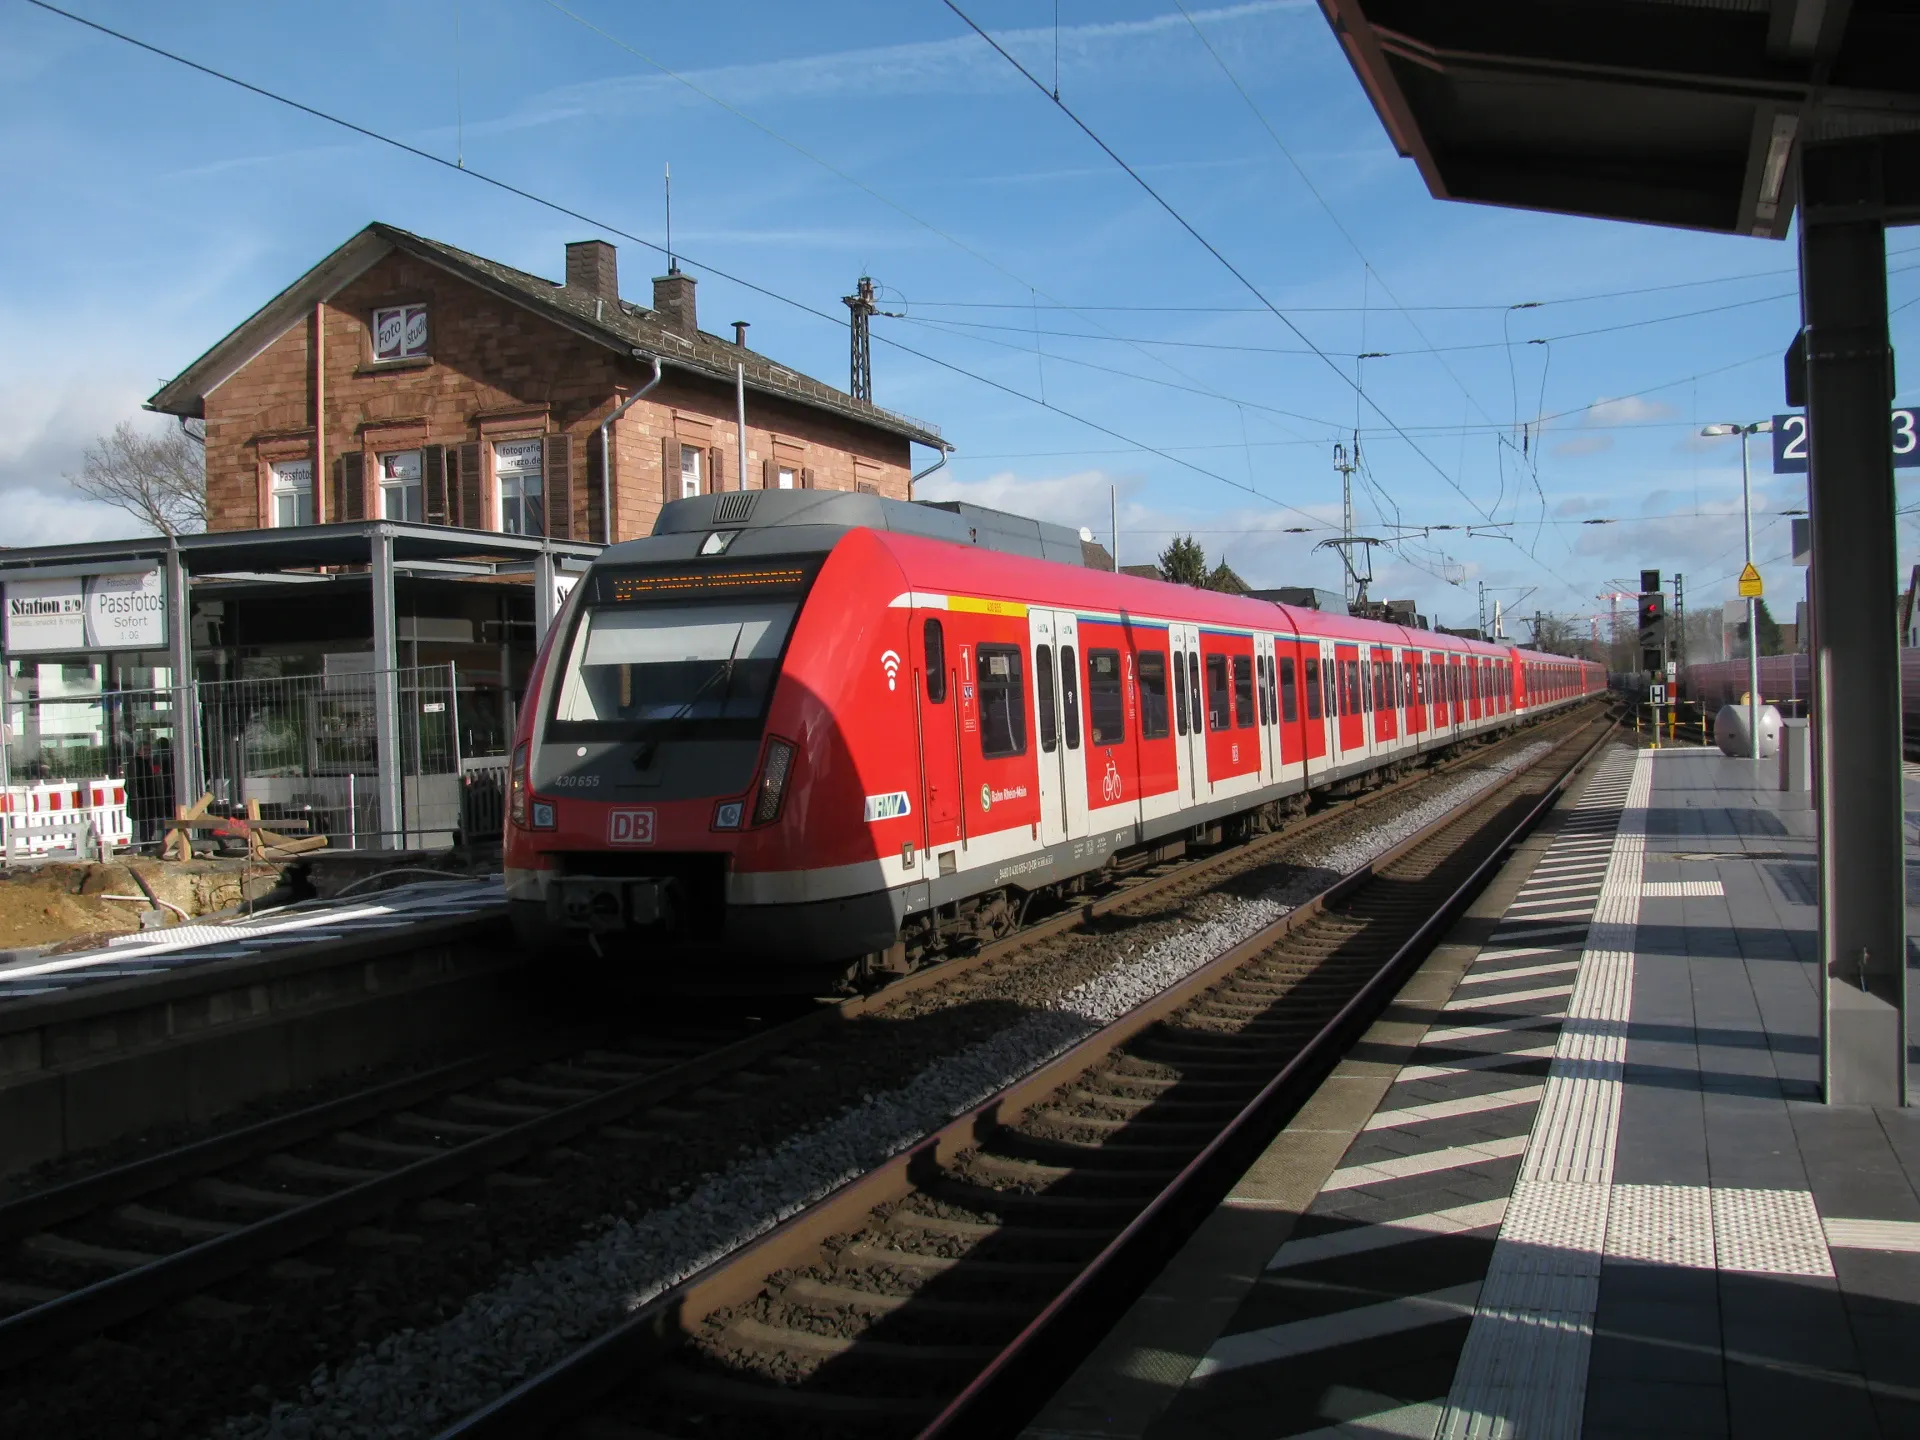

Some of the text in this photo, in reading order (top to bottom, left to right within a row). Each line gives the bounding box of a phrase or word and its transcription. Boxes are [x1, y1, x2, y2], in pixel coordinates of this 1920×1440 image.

[380, 321, 401, 349] Foto
[1782, 416, 1807, 460] 2
[1891, 410, 1917, 454] 3
[502, 444, 541, 456] fotografie
[12, 598, 82, 615] Station 8/9
[100, 591, 166, 614] Passfotos
[114, 616, 148, 628] Sofort
[962, 648, 970, 681] 1
[1127, 654, 1134, 680] 2
[1652, 686, 1663, 704] H
[555, 775, 600, 788] 430 655
[613, 813, 651, 840] DB
